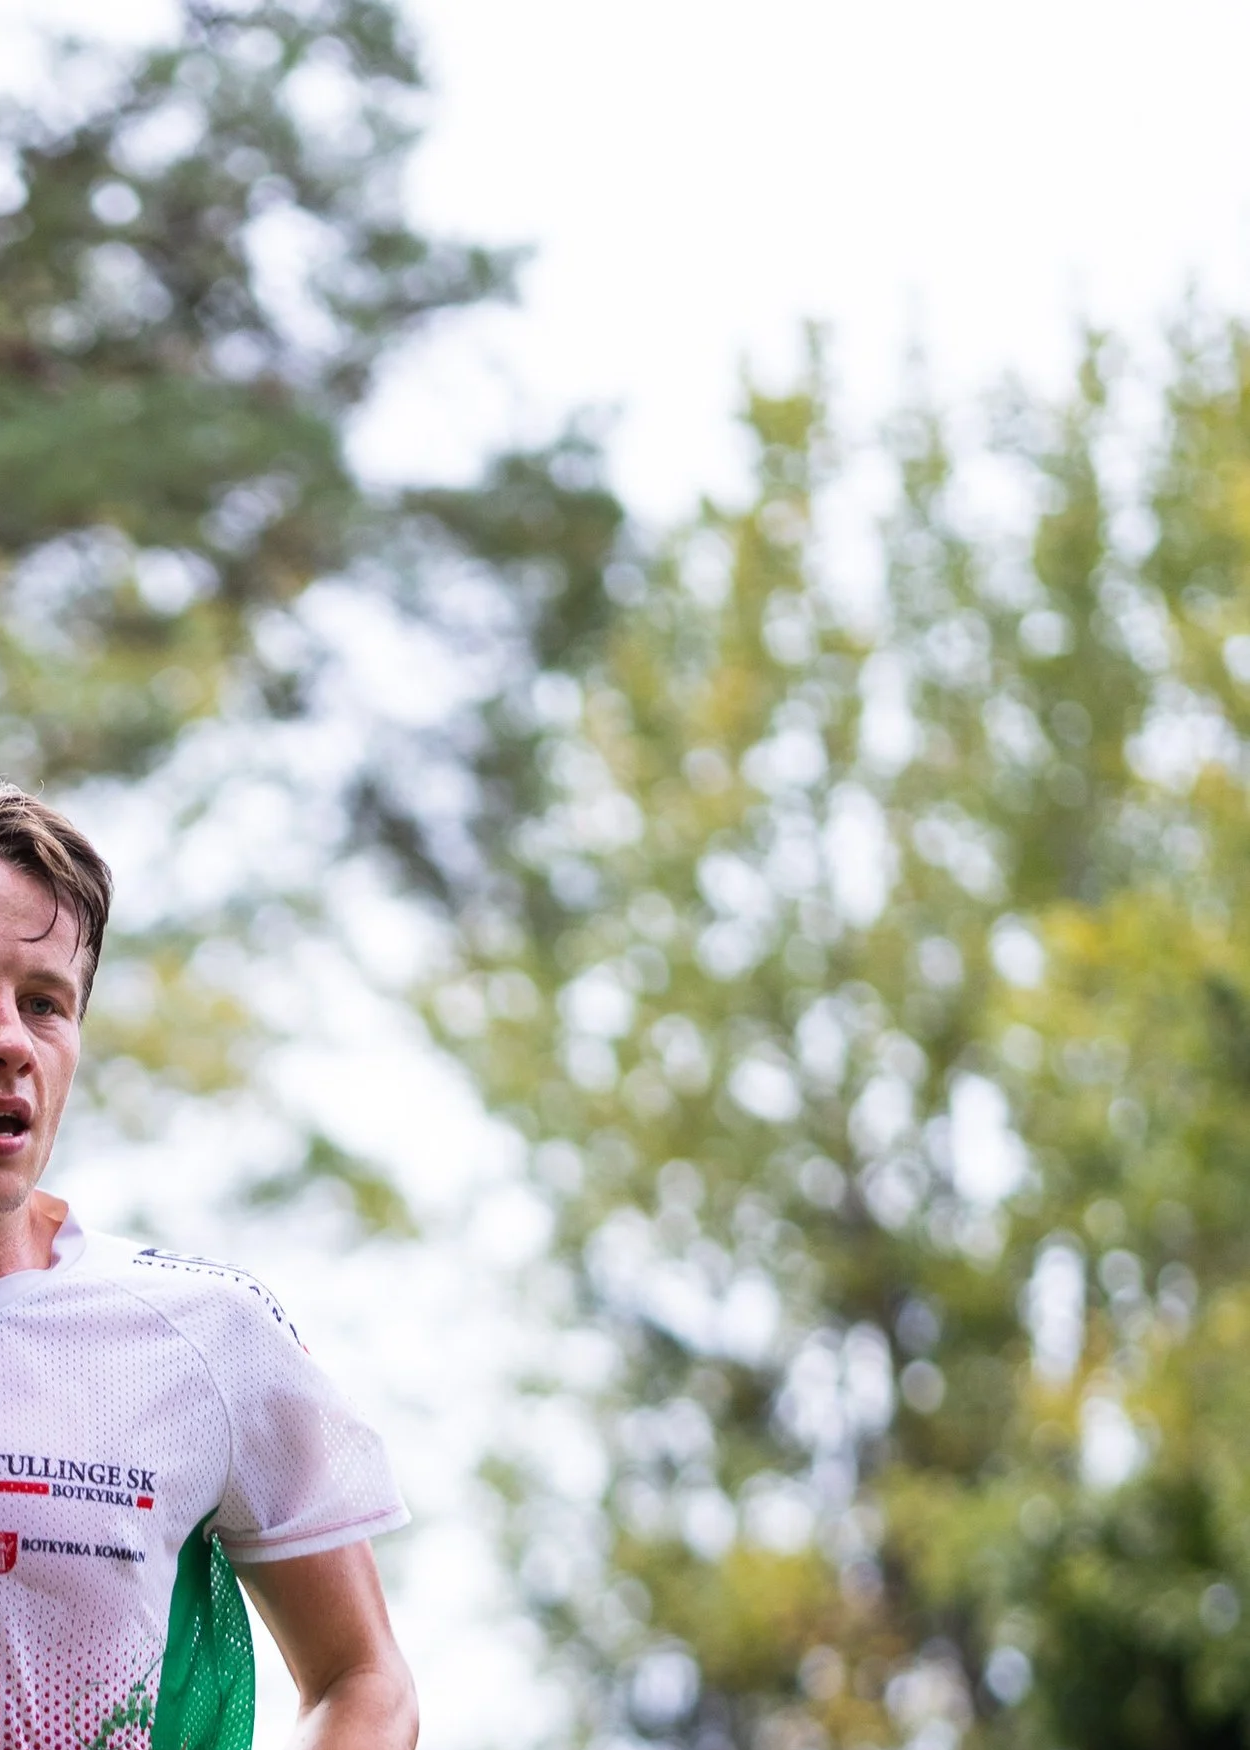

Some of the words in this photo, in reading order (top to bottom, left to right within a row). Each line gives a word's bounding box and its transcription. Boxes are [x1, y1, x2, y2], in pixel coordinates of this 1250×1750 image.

[126, 1468, 156, 1493] SK
[51, 1483, 134, 1507] BOTKYRKA
[21, 1538, 91, 1557] BOTKYRKA
